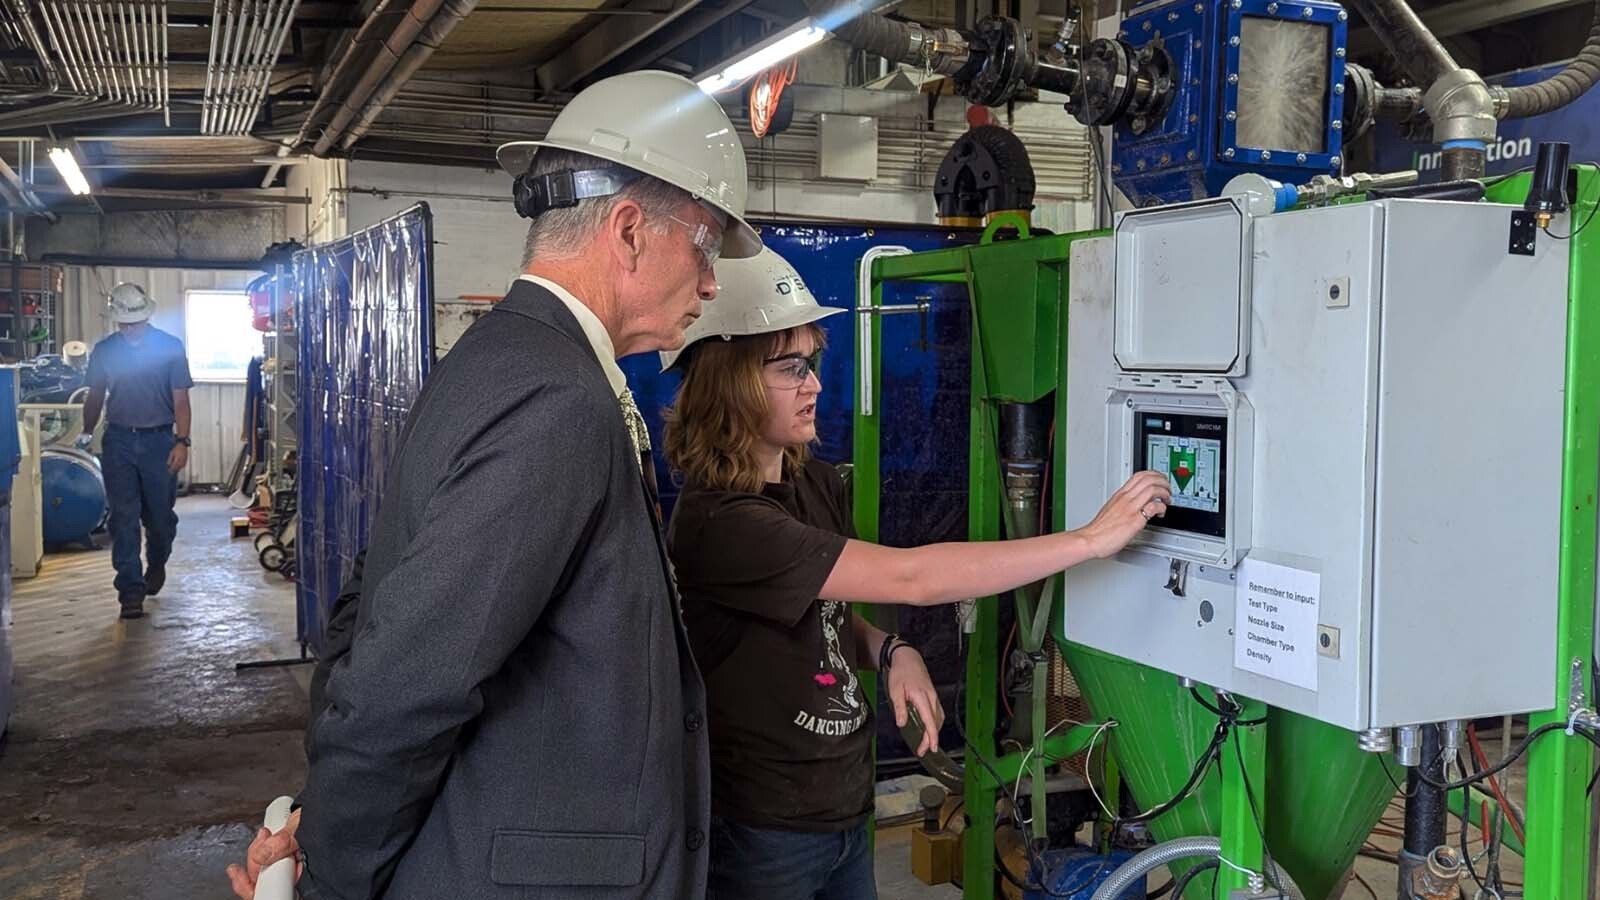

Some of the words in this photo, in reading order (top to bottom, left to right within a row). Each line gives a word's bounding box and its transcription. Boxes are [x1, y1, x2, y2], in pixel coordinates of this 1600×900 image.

[1412, 136, 1532, 171] Inntion
[1248, 581, 1285, 598] Remember
[1286, 590, 1294, 600] to
[1294, 591, 1316, 605] input:
[1248, 598, 1262, 609] Test
[1263, 601, 1278, 613] Type
[1247, 615, 1270, 628] Nozzle
[1270, 620, 1285, 632] Size
[1247, 631, 1278, 648] Chamber
[1279, 639, 1295, 652] Type
[1246, 648, 1272, 664] Density
[793, 710, 852, 736] DANCING
